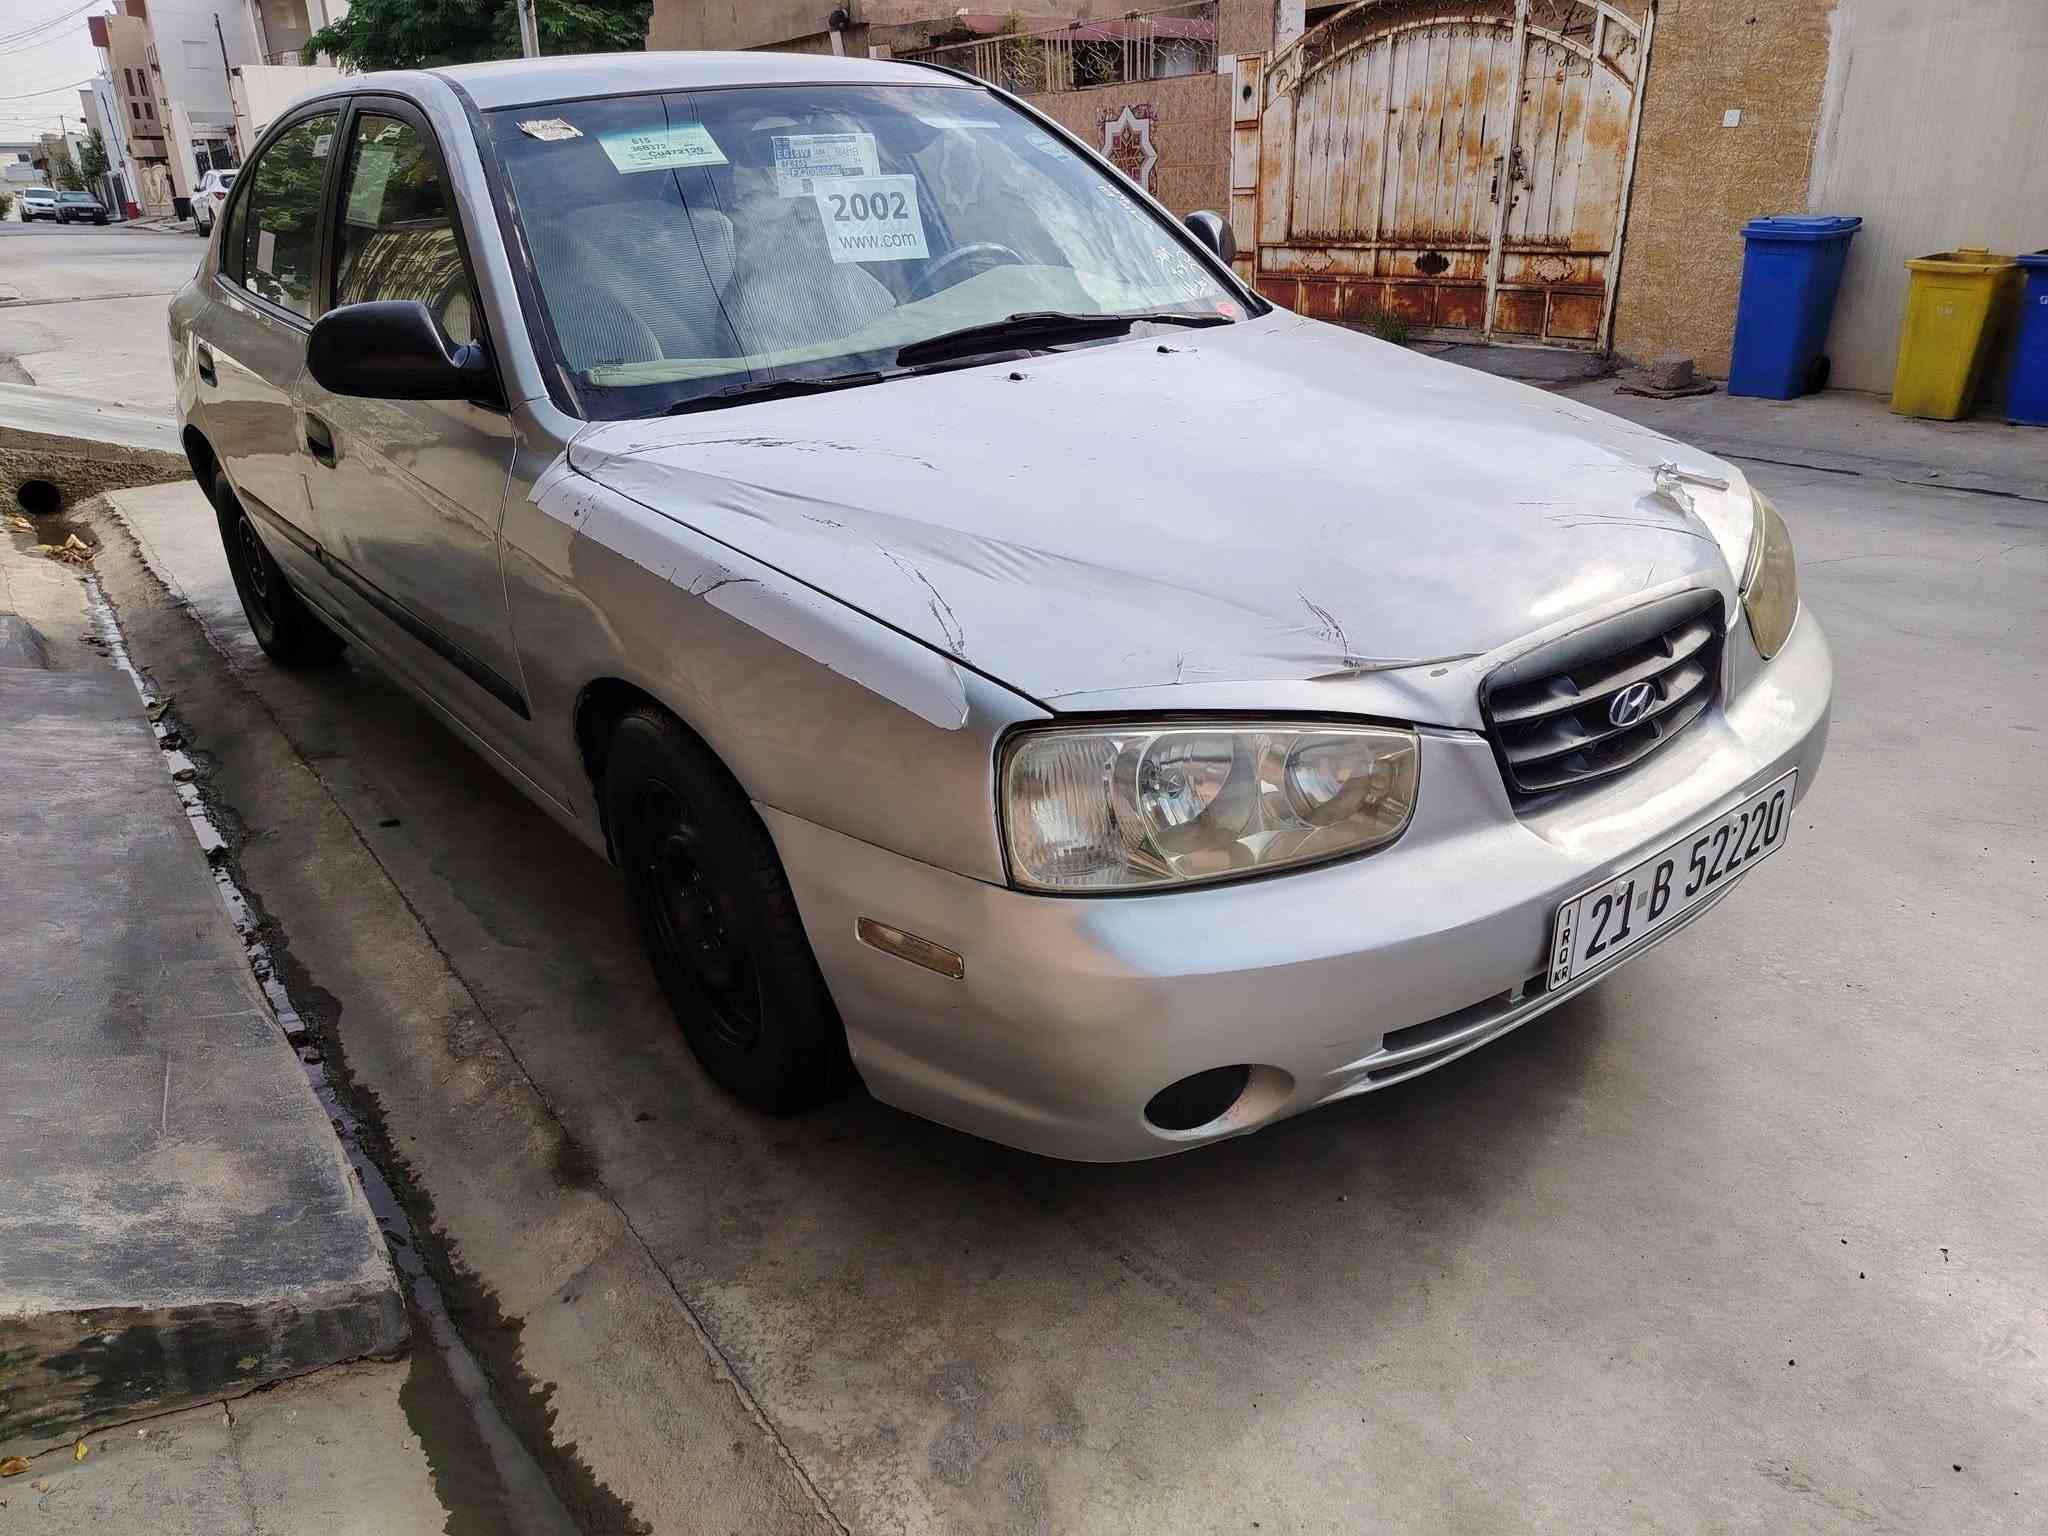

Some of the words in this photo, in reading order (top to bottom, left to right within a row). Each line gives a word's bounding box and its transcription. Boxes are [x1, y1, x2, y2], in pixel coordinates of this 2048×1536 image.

[828, 191, 909, 221] 2002
[839, 232, 917, 249] www.com
[1585, 879, 1635, 961] 21
[1647, 859, 1674, 922] B
[1685, 788, 1785, 897] 52220
[1553, 965, 1569, 984] KR
